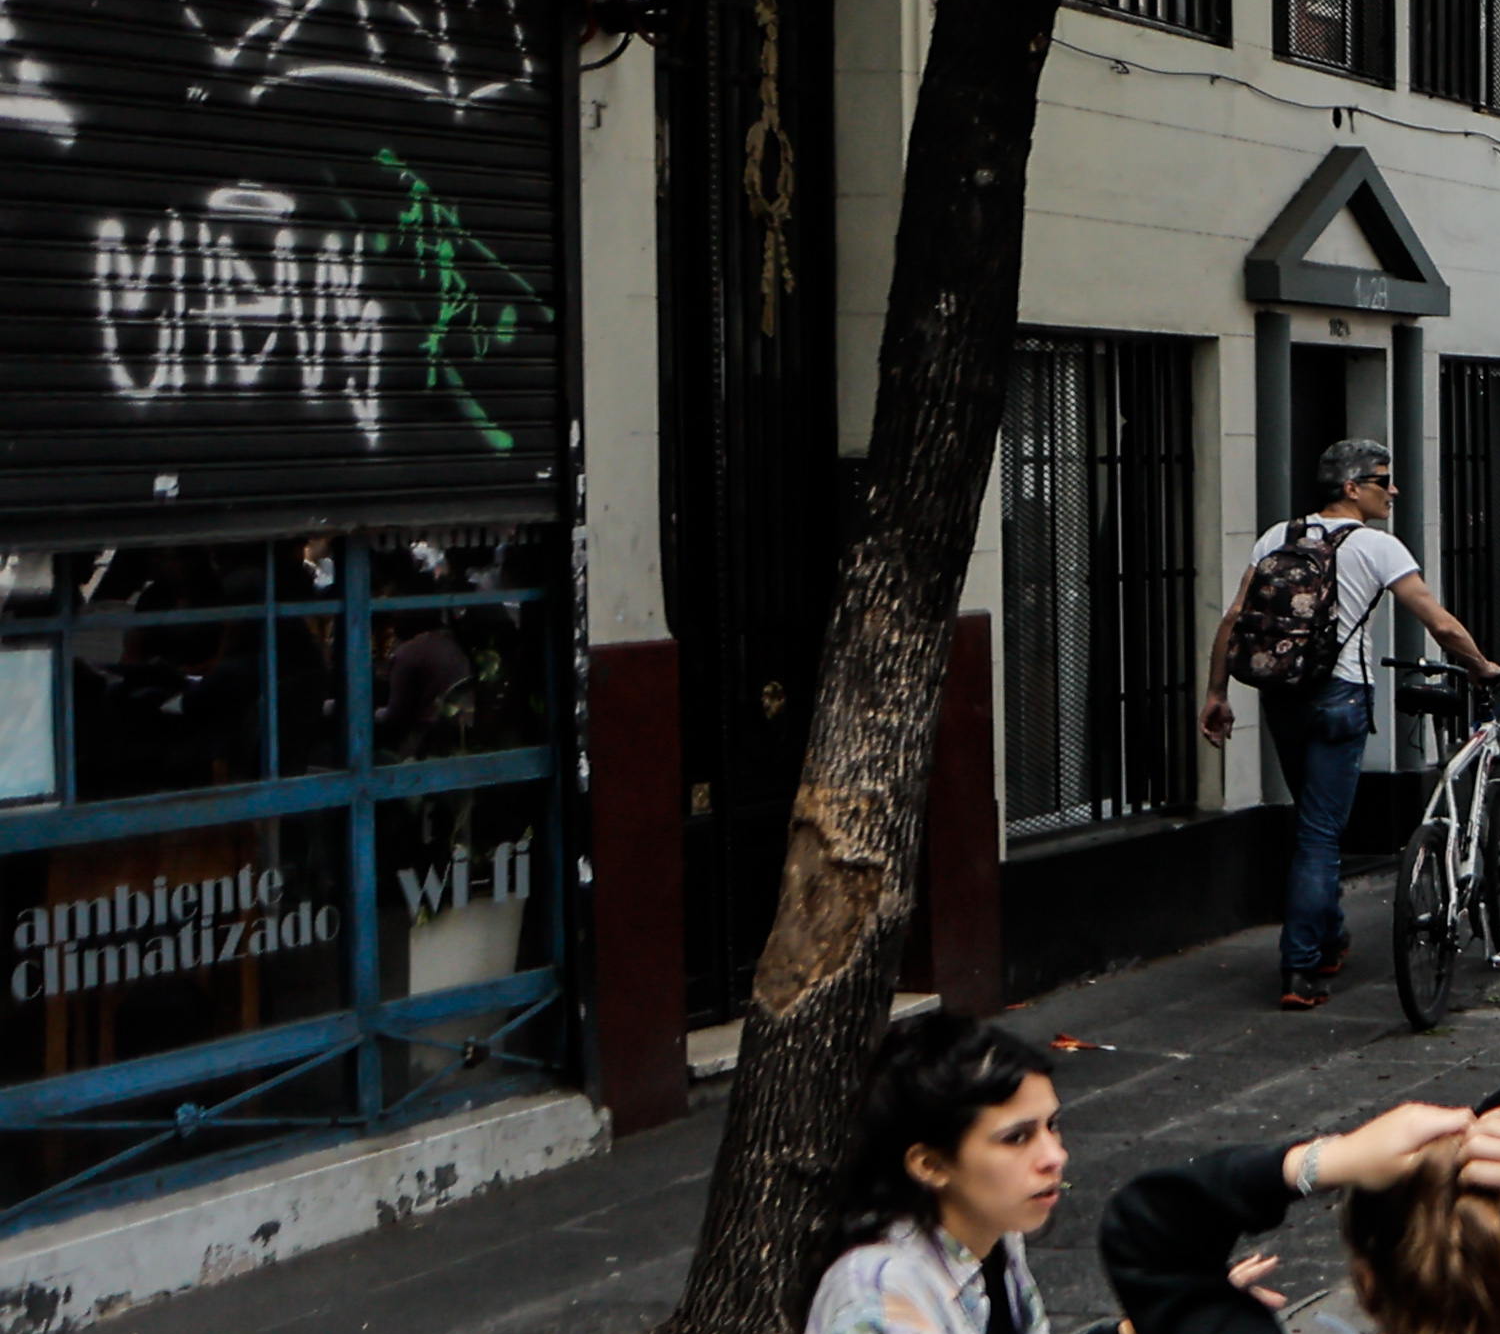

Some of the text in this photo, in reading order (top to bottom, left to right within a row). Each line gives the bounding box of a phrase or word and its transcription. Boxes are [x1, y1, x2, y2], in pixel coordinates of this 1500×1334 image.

[14, 863, 285, 950] ambiente
[397, 839, 532, 917] wi-fi
[10, 900, 341, 1003] climatizado
